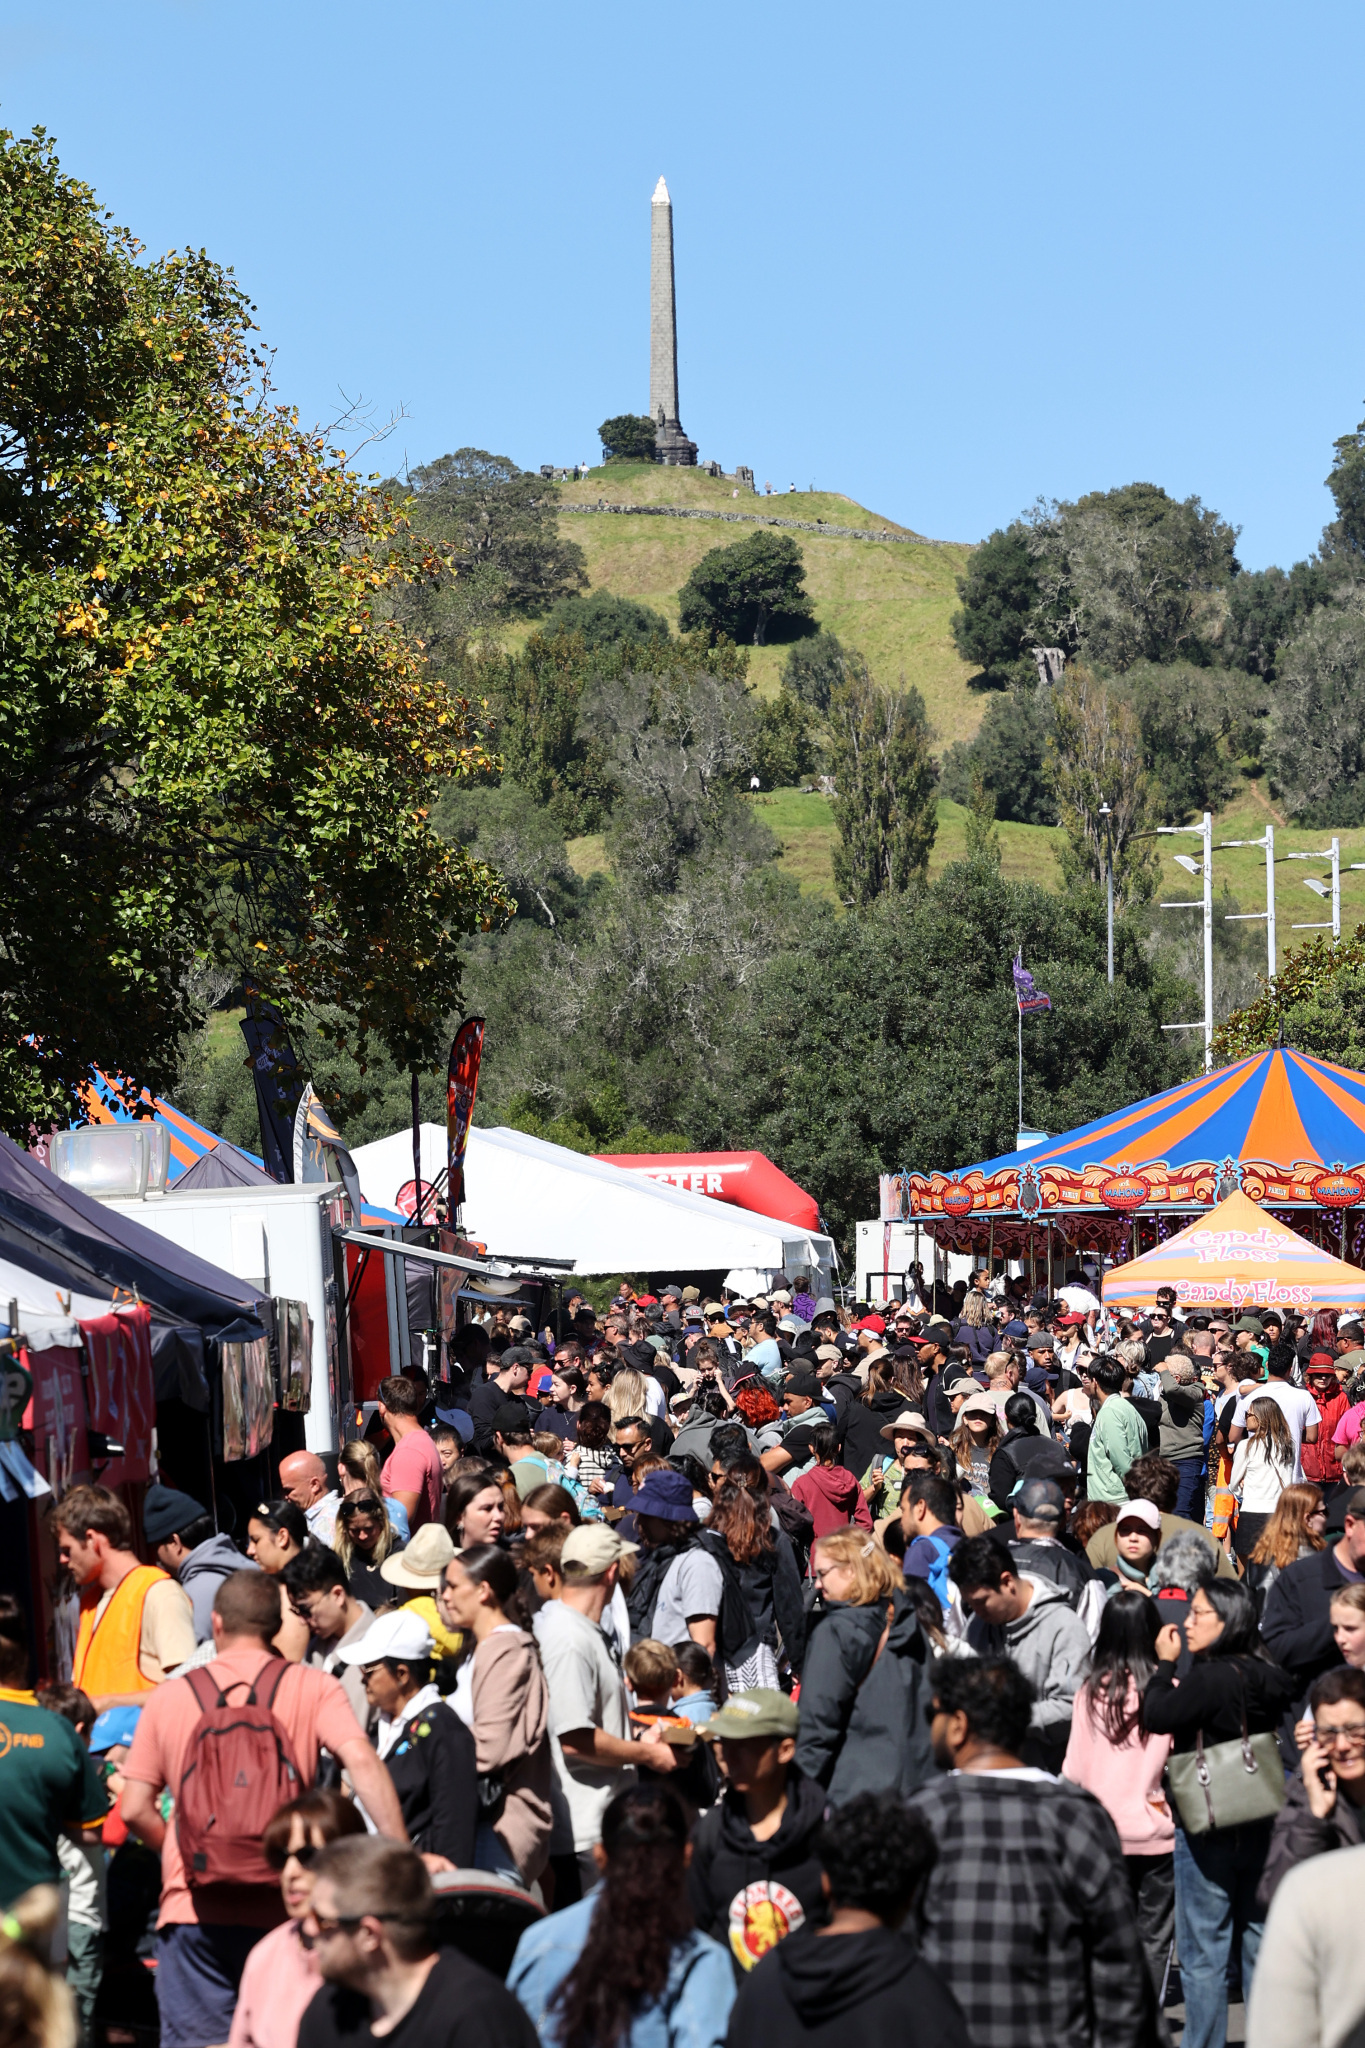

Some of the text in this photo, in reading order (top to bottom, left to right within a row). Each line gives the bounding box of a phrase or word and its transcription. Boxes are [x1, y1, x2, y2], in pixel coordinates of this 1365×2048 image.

[1105, 1188, 1145, 1198] MAHONS
[1268, 1185, 1306, 1196] FAMILY FUN
[1317, 1187, 1360, 1196] MAHONS
[944, 1195, 970, 1205] MAHONS
[1188, 1228, 1288, 1248] Candy
[1195, 1246, 1279, 1262] Floss
[1174, 1279, 1312, 1305] Candy Floss
